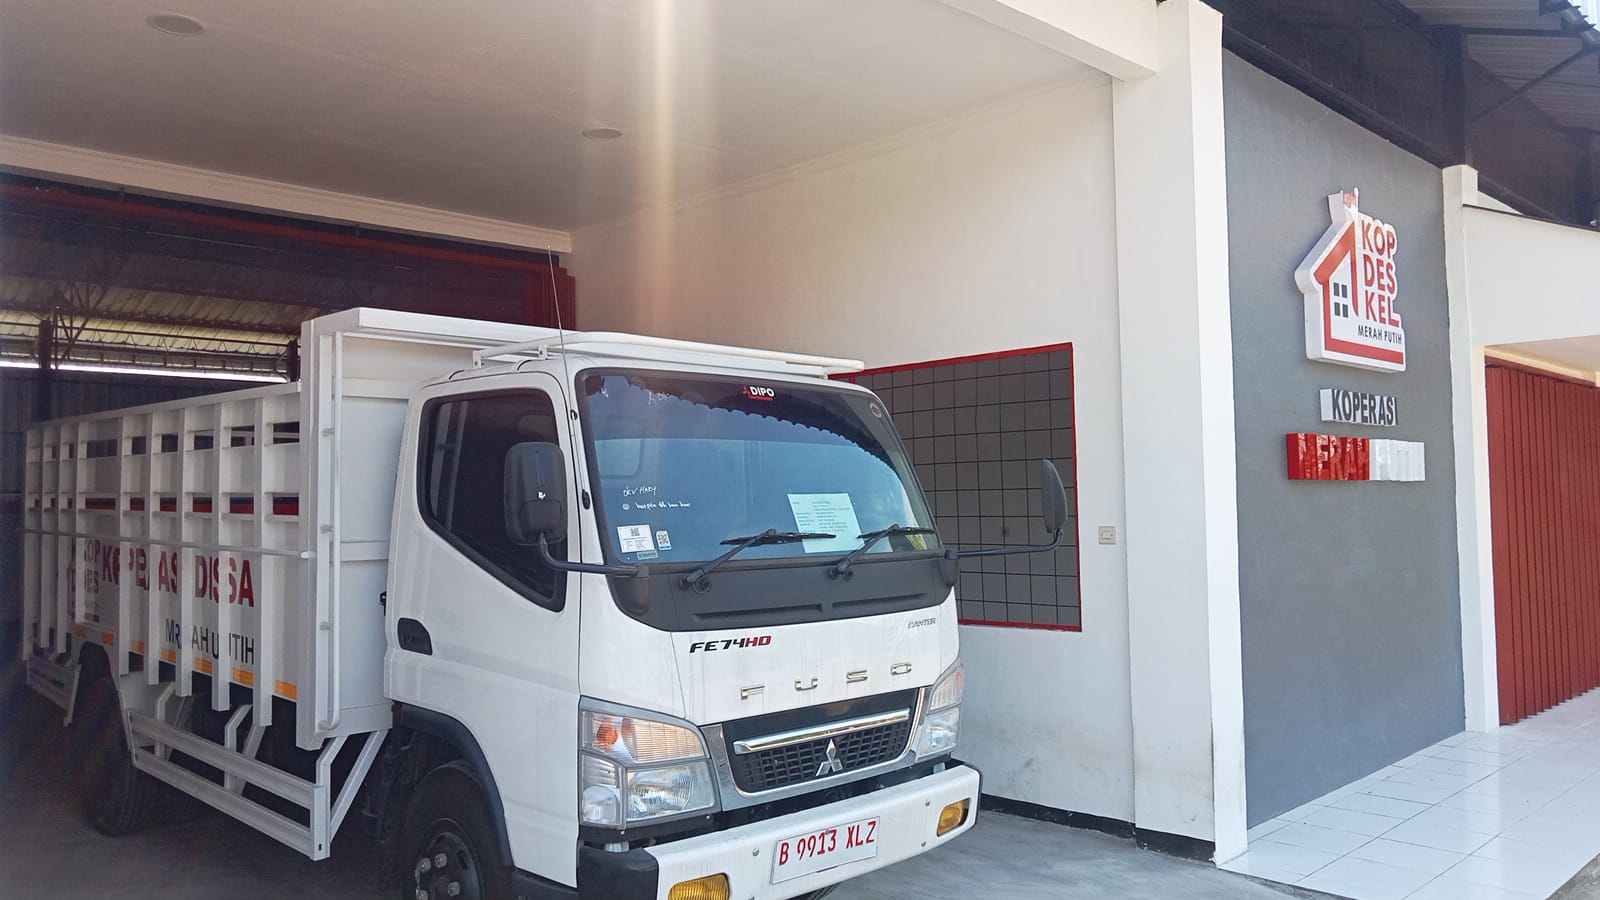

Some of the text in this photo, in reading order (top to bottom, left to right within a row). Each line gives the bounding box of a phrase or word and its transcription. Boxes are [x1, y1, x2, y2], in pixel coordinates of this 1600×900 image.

[1362, 219, 1396, 259] KOP
[1363, 253, 1396, 295] DES
[1365, 290, 1400, 328] KEL
[1358, 324, 1402, 345] MERAH PUTIH
[1331, 388, 1399, 426] KOPERASI
[1297, 432, 1370, 481] MERAH
[690, 636, 772, 653] FE74HD
[740, 662, 912, 700] FUSO
[779, 820, 877, 866] B 9913 XLZ
